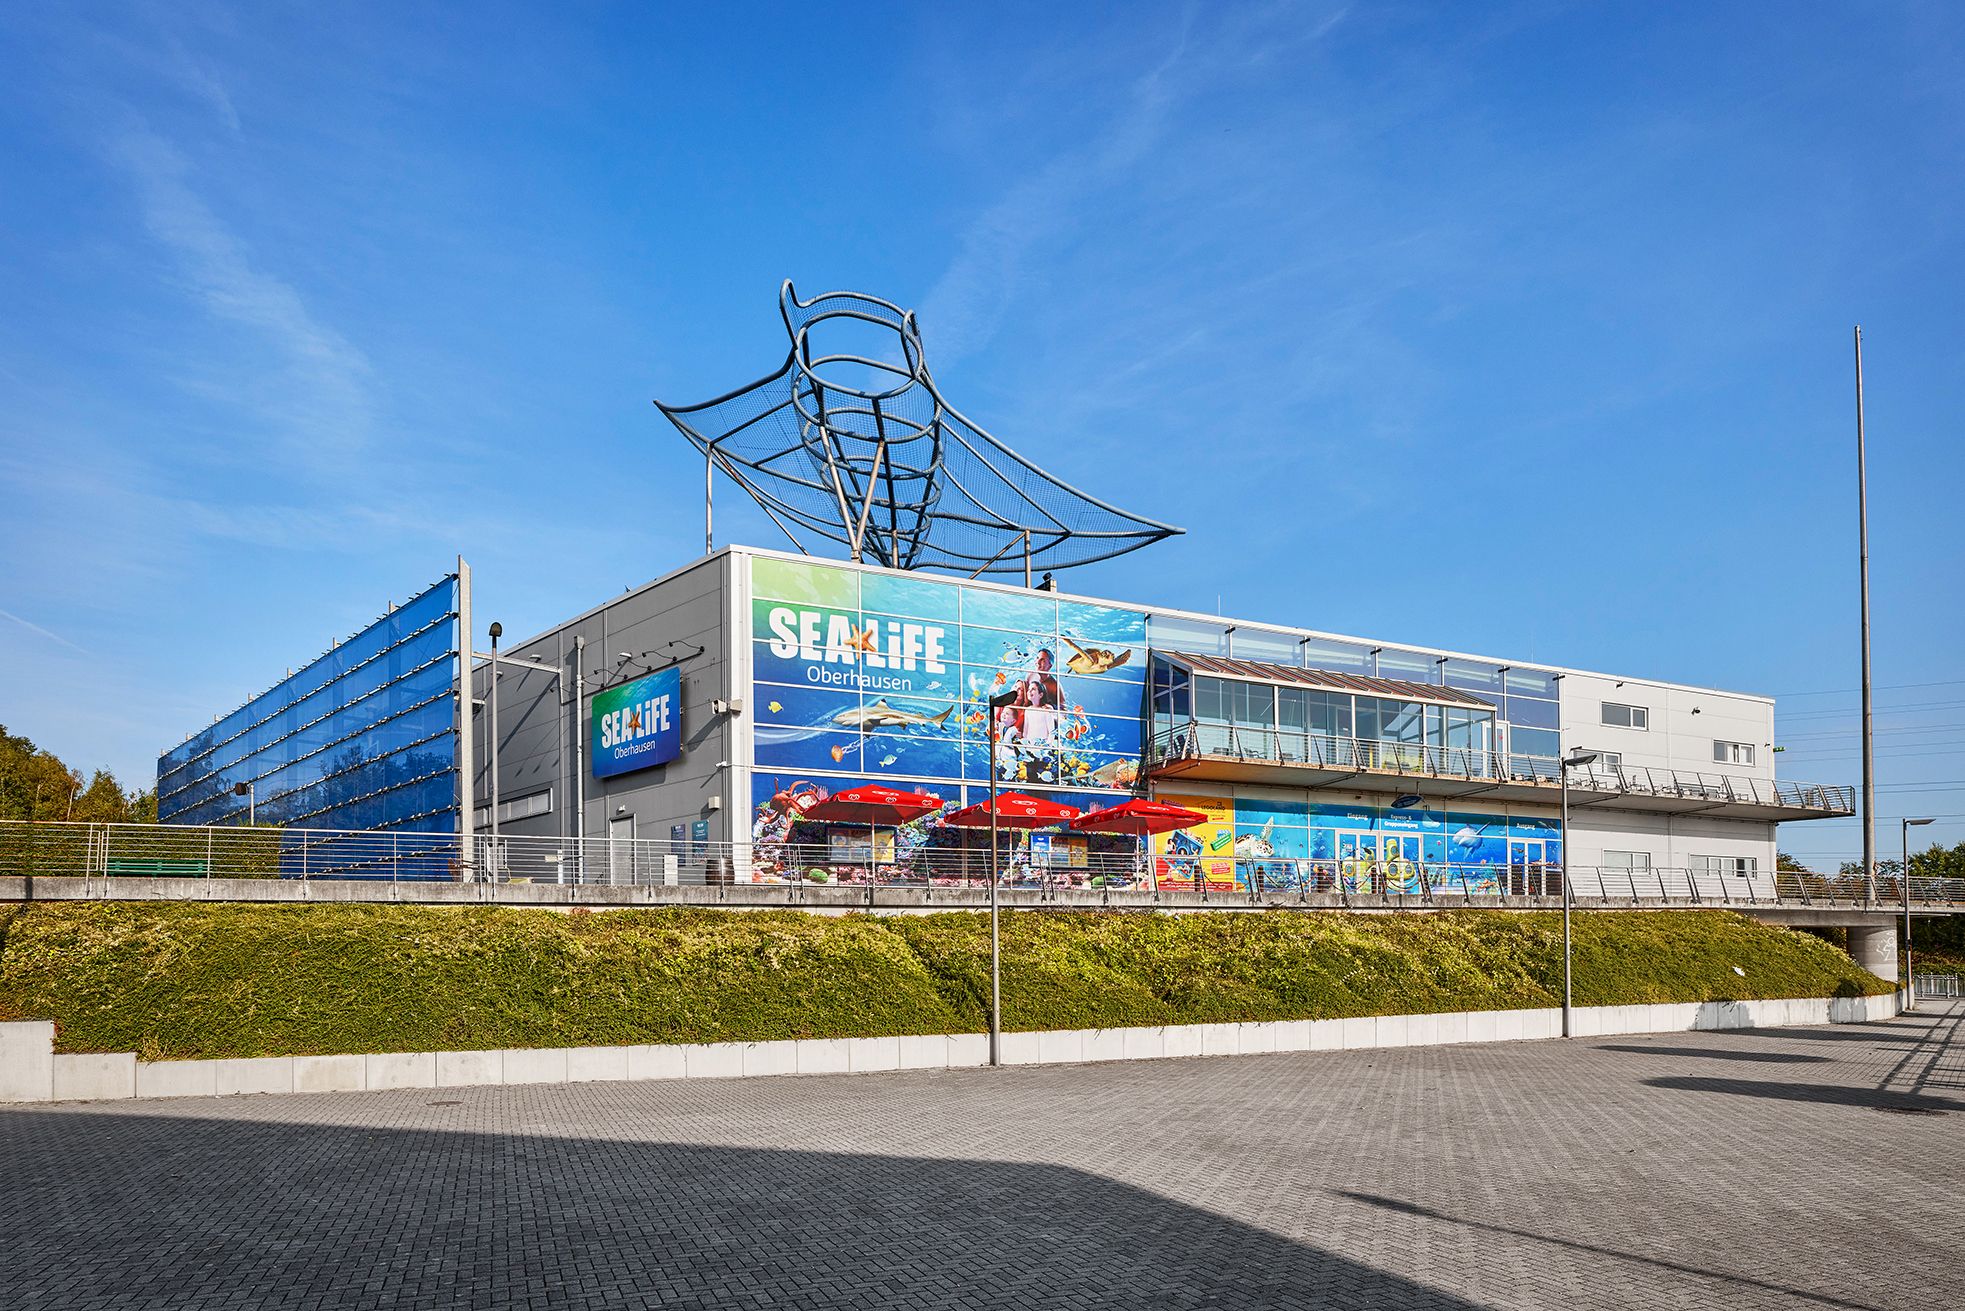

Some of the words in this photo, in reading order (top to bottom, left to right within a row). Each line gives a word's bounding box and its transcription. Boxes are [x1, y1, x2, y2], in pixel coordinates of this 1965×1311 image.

[768, 607, 855, 665] SEA
[806, 665, 912, 692] Oberhausen
[601, 706, 633, 749] SEA
[614, 740, 656, 760] Oberhausen
[1347, 812, 1369, 821] Eingang
[1515, 822, 1536, 831] Ausgang
